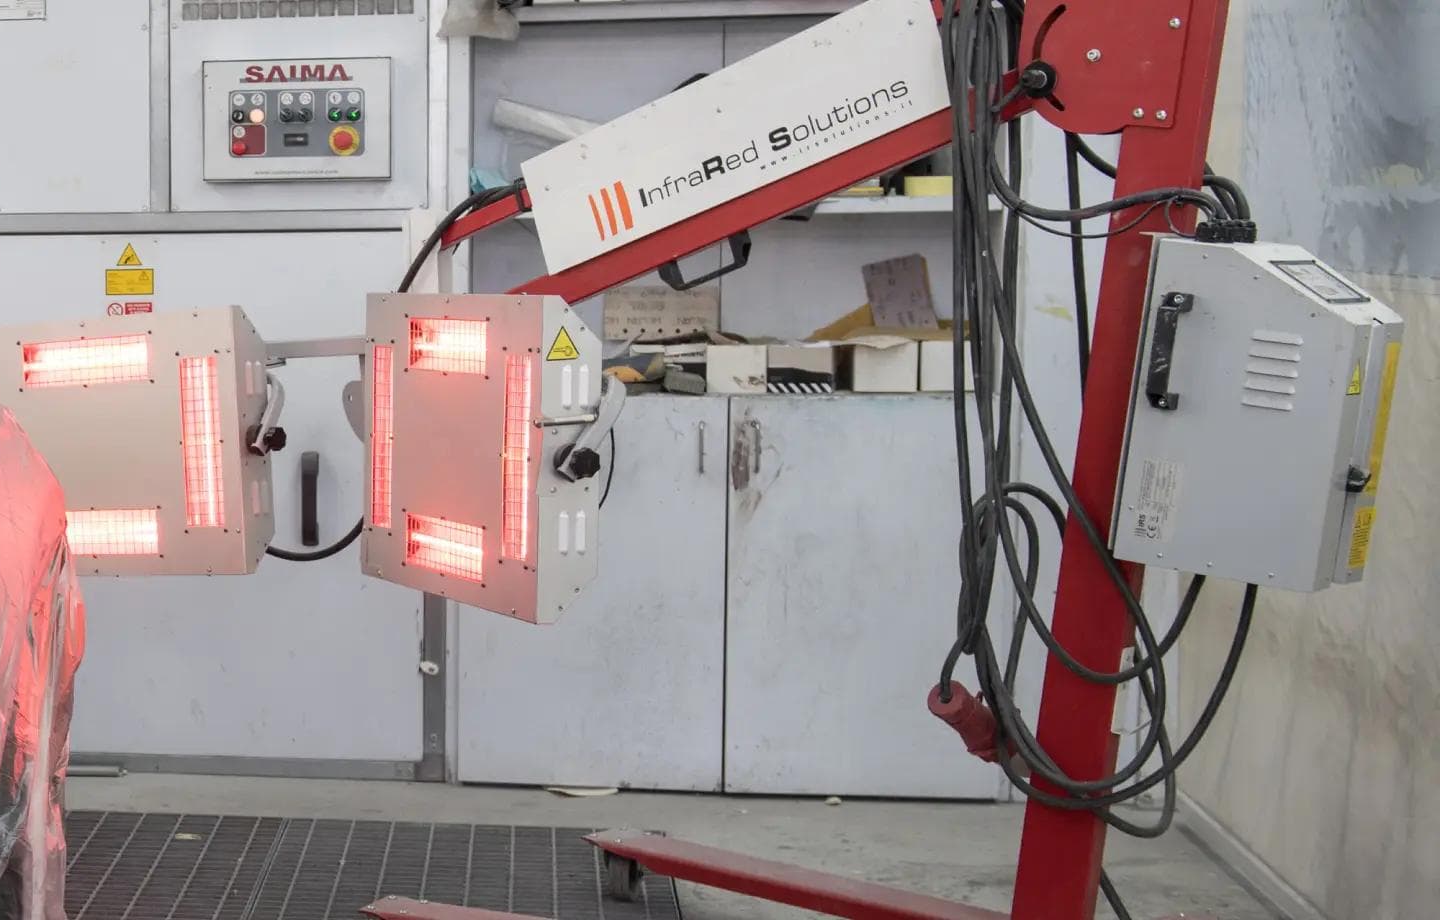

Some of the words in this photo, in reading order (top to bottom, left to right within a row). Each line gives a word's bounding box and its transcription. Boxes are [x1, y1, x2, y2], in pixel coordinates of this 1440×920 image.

[244, 64, 349, 83] SAIMA
[639, 140, 761, 208] InfraRed
[768, 79, 909, 152] Solutions
